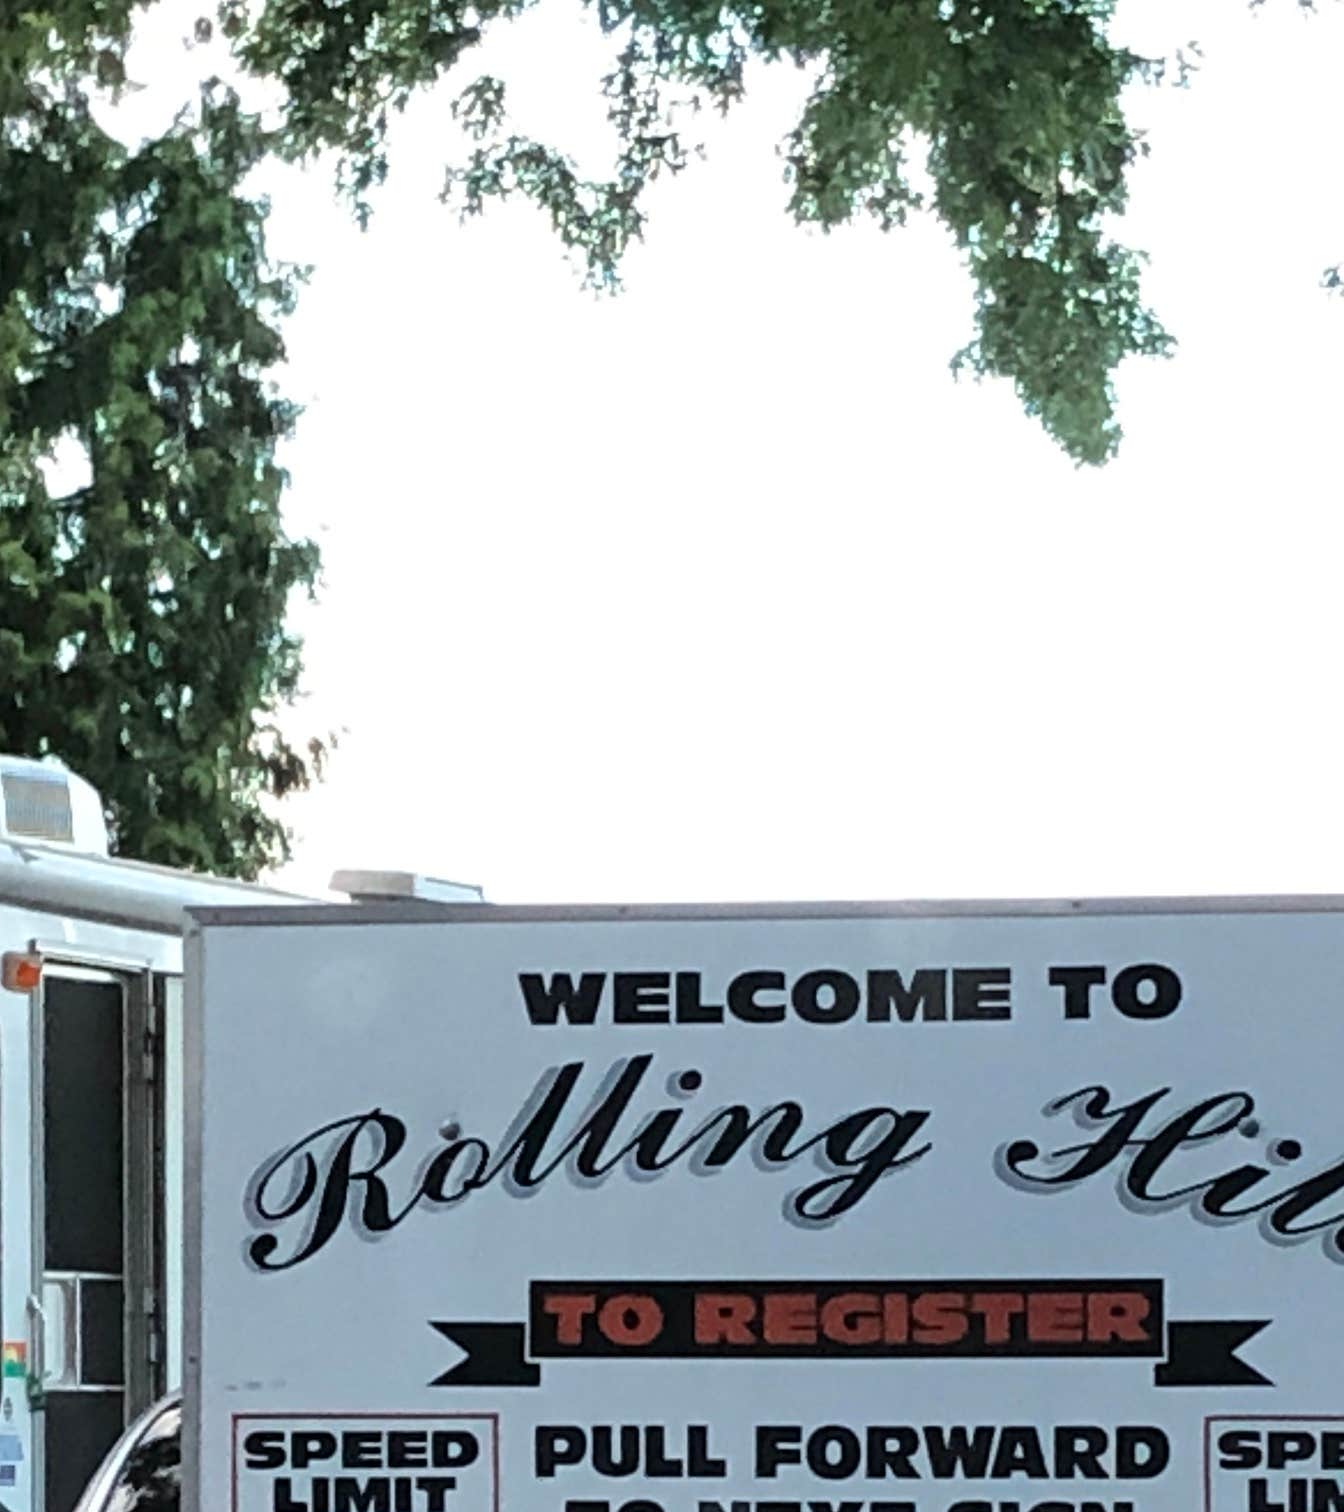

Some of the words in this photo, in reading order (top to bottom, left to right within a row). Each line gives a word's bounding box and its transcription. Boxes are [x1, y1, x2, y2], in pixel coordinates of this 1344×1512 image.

[518, 969, 1011, 1025] WELCOME
[1049, 964, 1182, 1020] TO
[246, 1054, 932, 1271] Rolling
[544, 1292, 664, 1345] TO
[694, 1292, 1151, 1345] REGISTER
[244, 1430, 479, 1469] SPEED
[535, 1425, 726, 1478] PULL
[755, 1425, 1170, 1480] FORWARD
